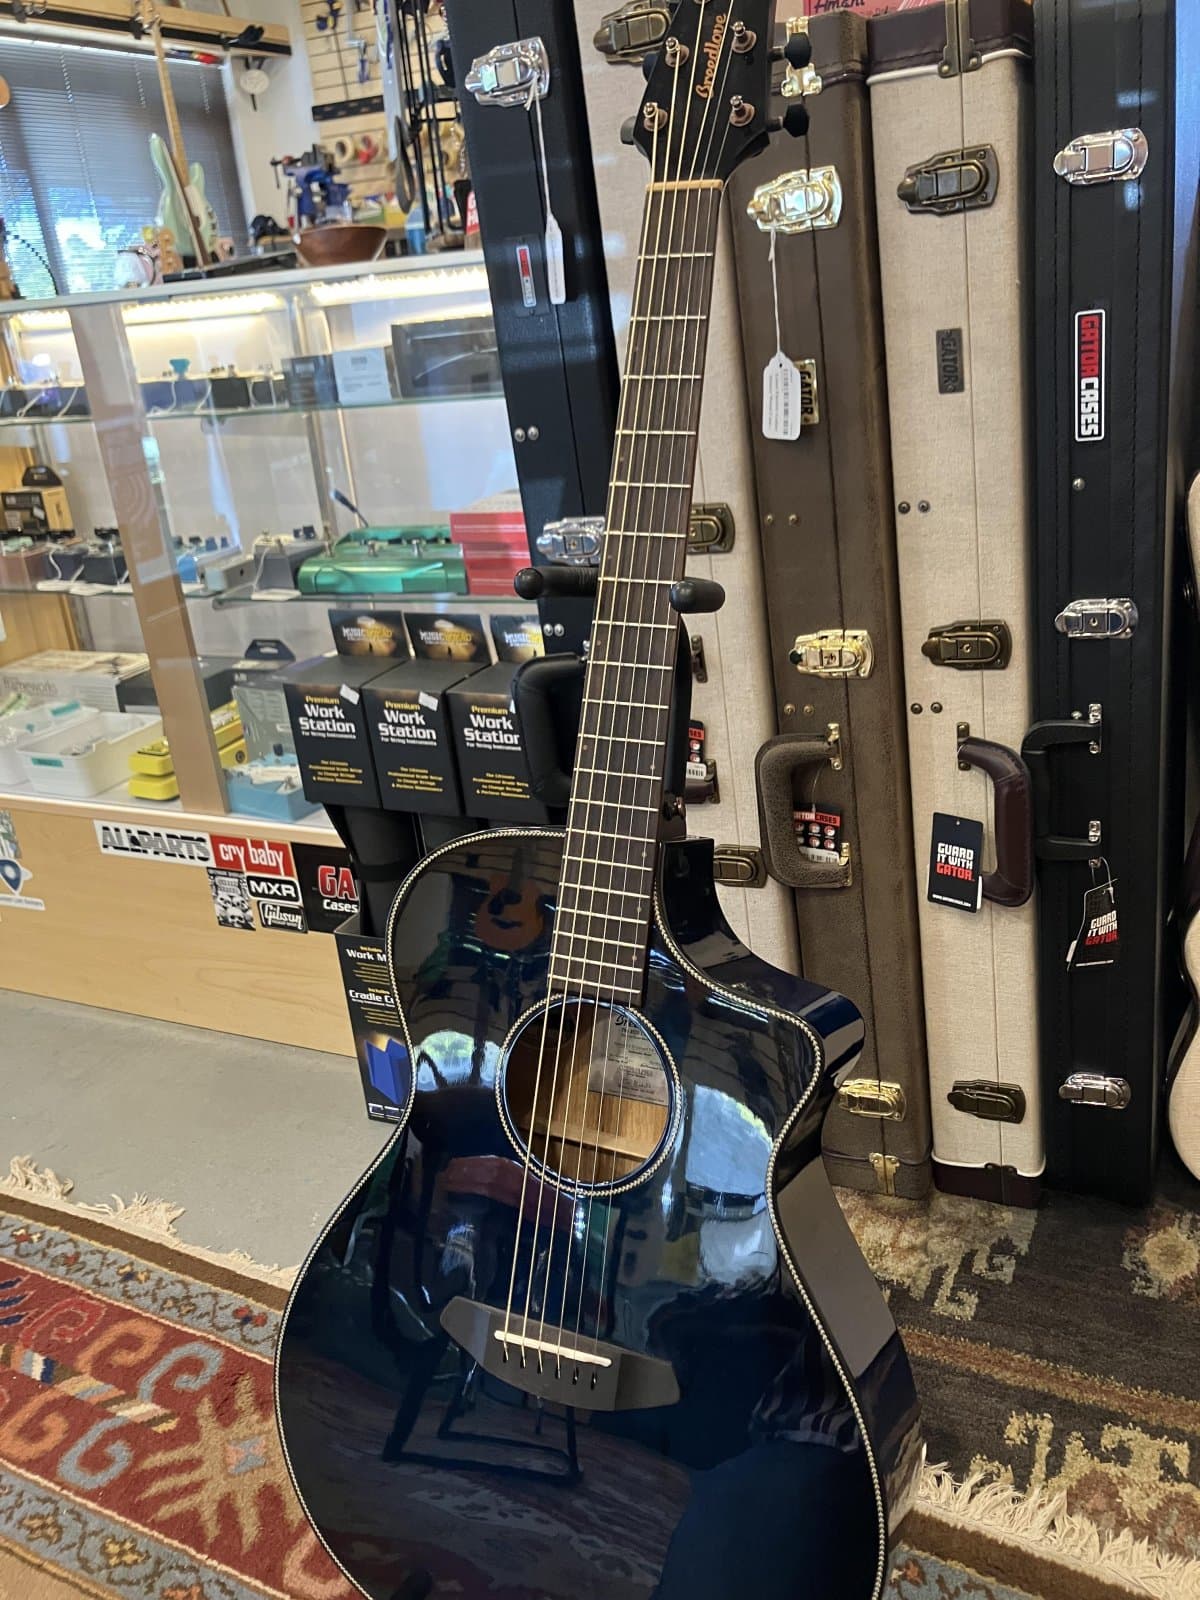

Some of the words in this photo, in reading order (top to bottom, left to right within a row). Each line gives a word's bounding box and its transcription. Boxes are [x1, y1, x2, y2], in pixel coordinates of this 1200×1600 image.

[695, 13, 726, 99] Breedlove
[941, 337, 959, 386] GATOR
[305, 695, 340, 705] Premium
[384, 700, 421, 711] Premium
[304, 703, 345, 719] Work
[383, 709, 426, 725] Work
[471, 705, 508, 715] Premium
[299, 717, 356, 734] Station
[469, 714, 513, 730] Work
[377, 723, 437, 740] Station
[101, 825, 211, 862] ALLPARTS
[937, 842, 974, 861] GUARD
[219, 843, 247, 873] cry
[247, 838, 285, 877] baby
[937, 853, 947, 864] IT
[948, 855, 973, 870] WITH
[936, 862, 973, 881] GATOR
[249, 880, 297, 898] MXR
[322, 899, 360, 914] Cases
[264, 903, 303, 931] Gibson
[1090, 909, 1117, 929] GUARD
[1087, 928, 1098, 938] IT
[1098, 920, 1118, 936] WITH
[346, 948, 375, 961] Work
[349, 989, 383, 1002] Cradle
